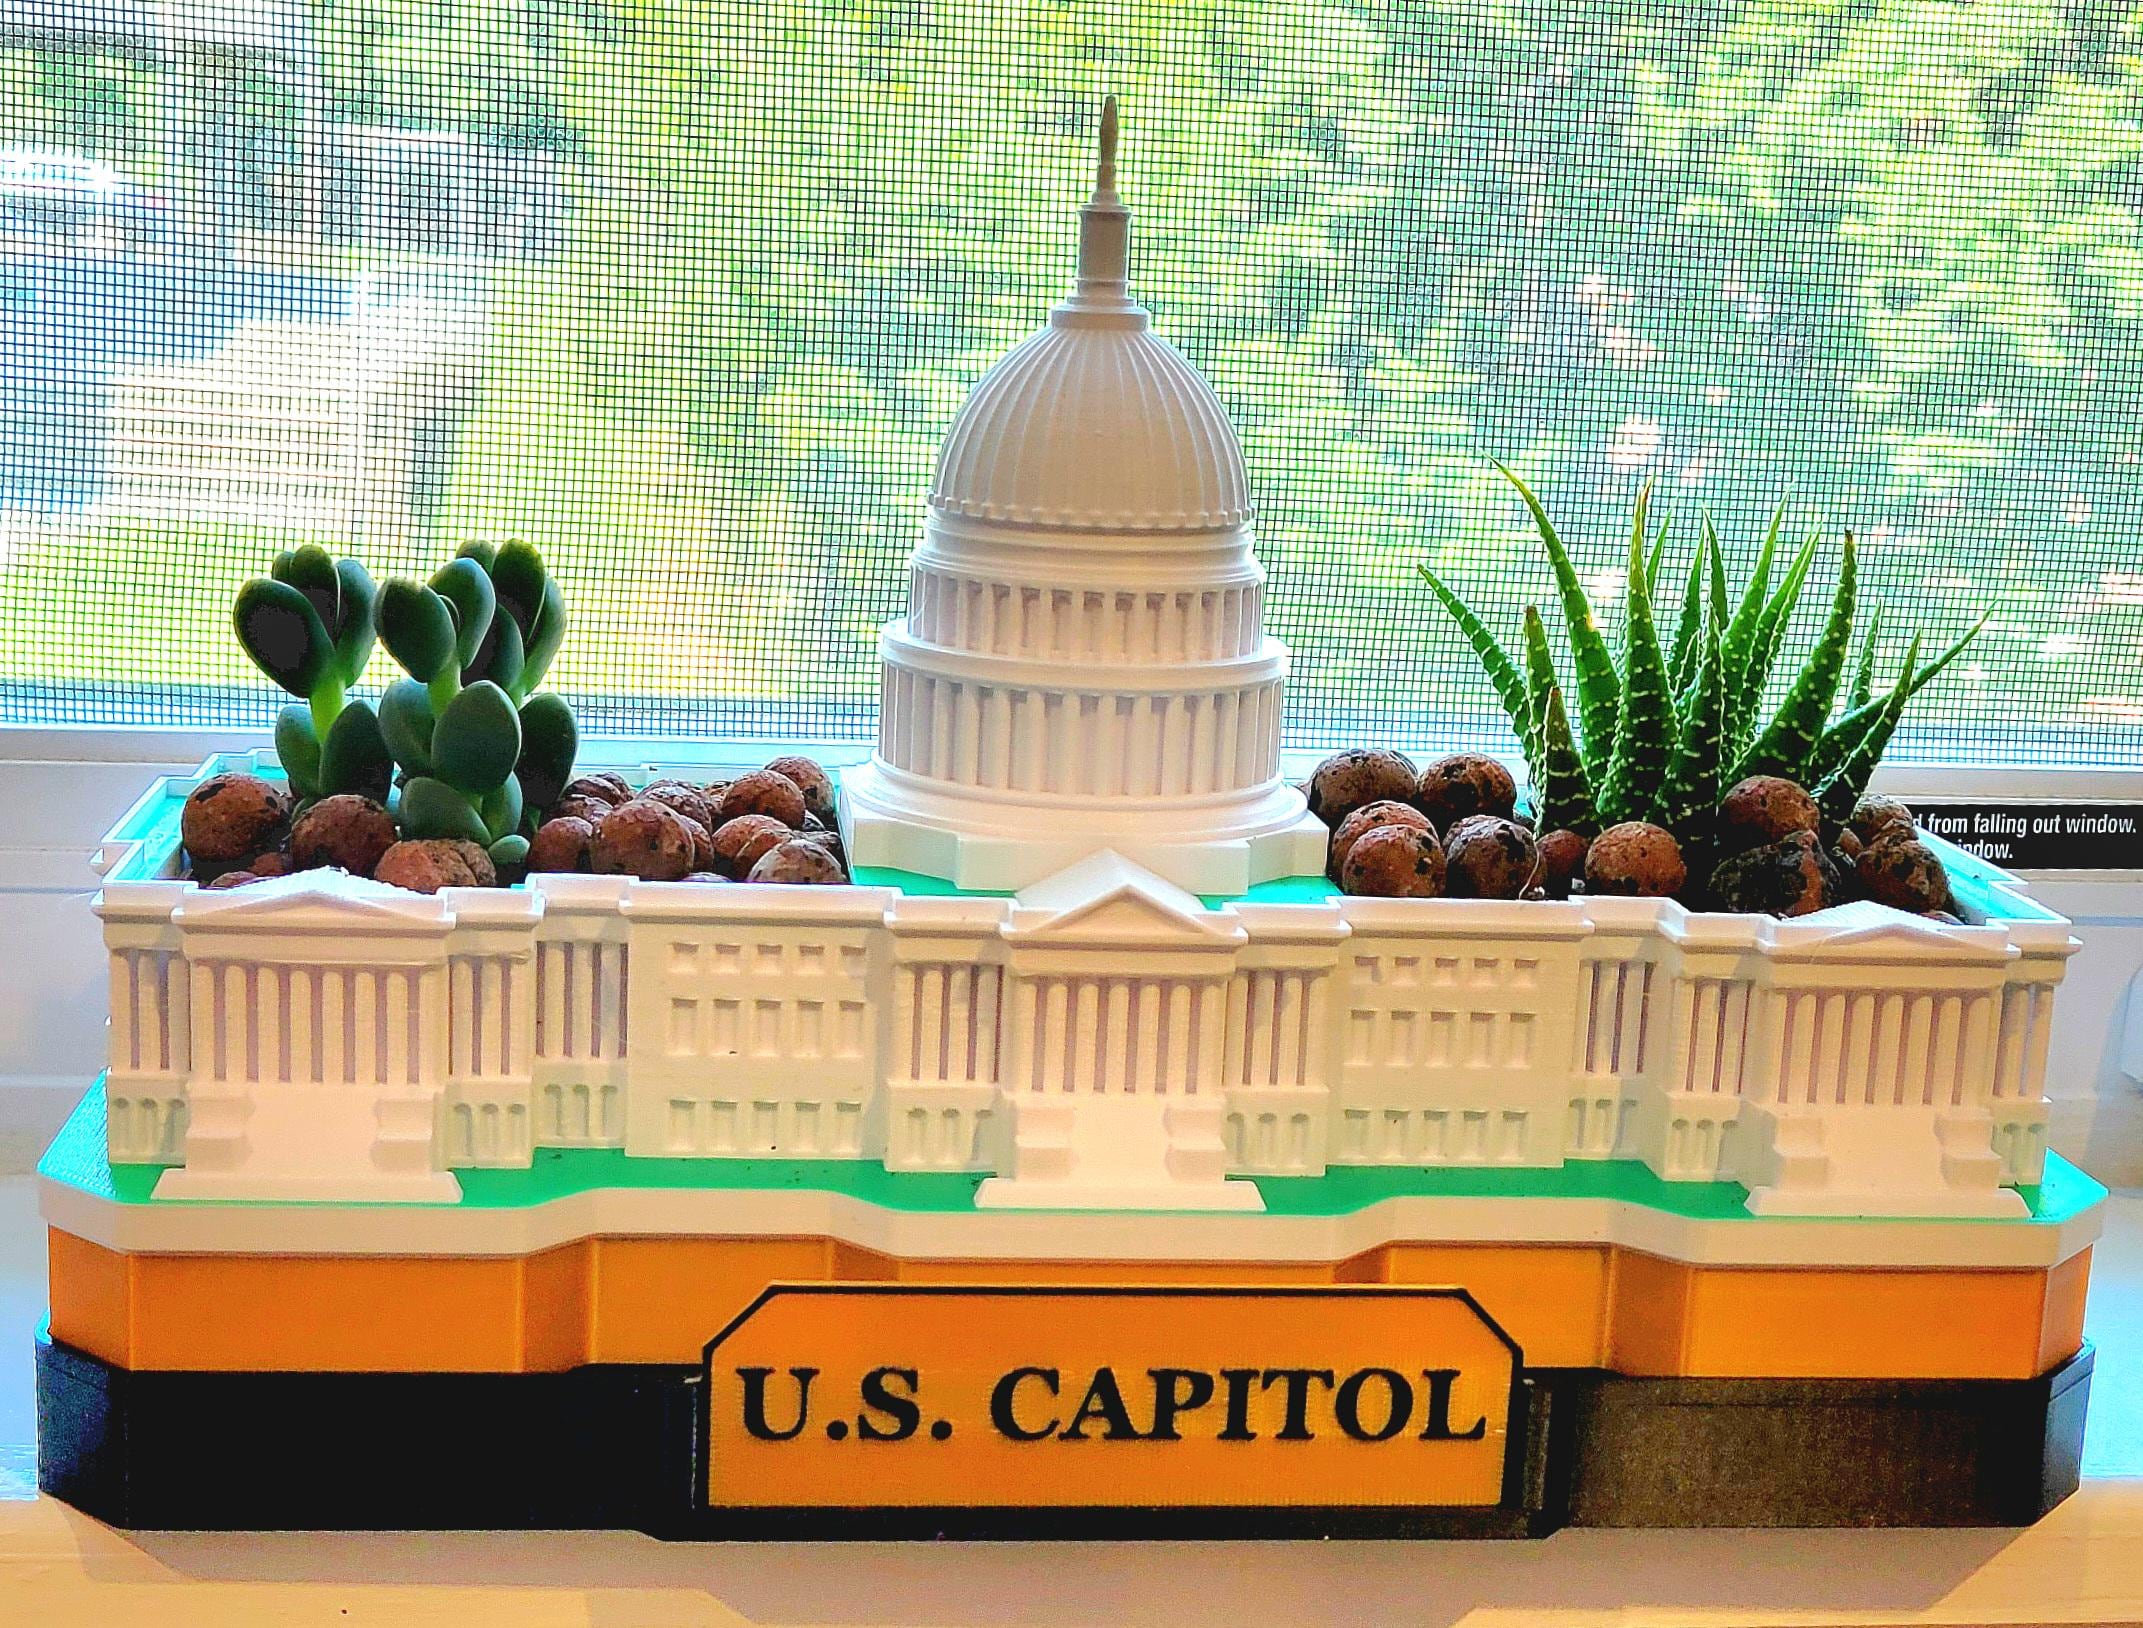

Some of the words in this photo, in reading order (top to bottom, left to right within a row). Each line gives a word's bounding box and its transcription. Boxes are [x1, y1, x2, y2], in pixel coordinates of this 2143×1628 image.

[1928, 812, 1968, 834] from
[1973, 812, 2027, 838] falling
[2032, 815, 2061, 834] out
[2065, 813, 2137, 834] window.
[735, 1366, 953, 1442] U.S.
[990, 1366, 1487, 1443] CAPITOL
